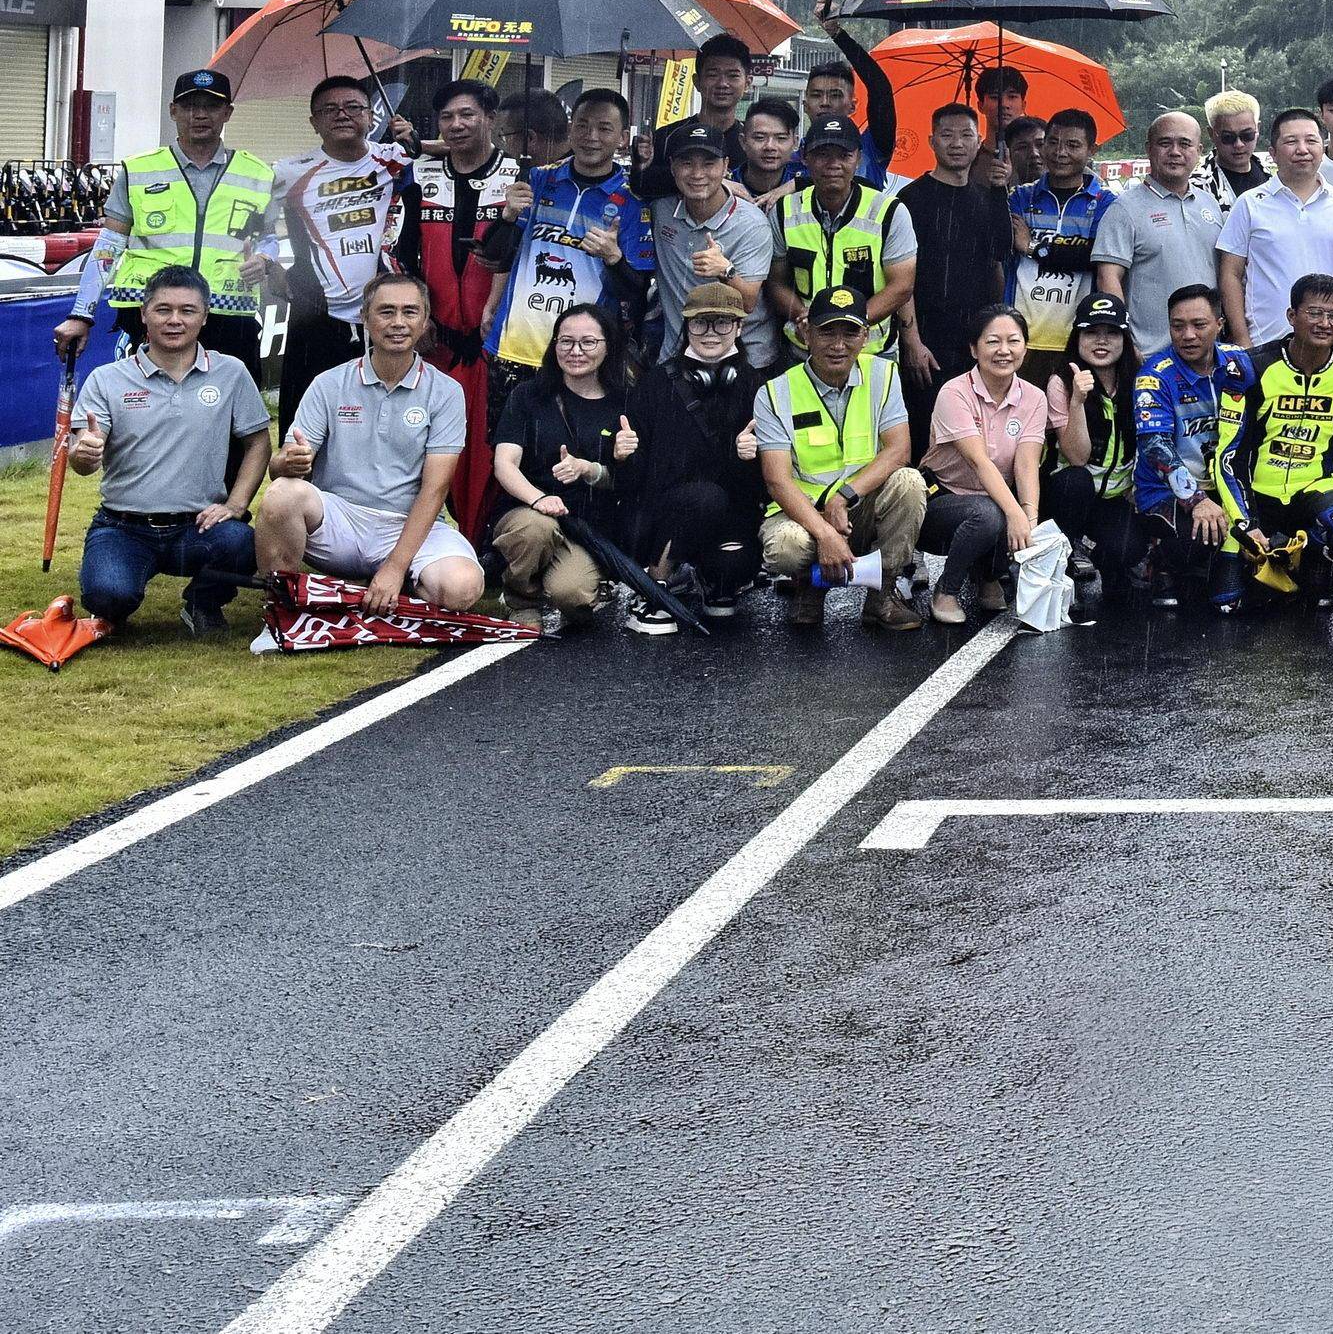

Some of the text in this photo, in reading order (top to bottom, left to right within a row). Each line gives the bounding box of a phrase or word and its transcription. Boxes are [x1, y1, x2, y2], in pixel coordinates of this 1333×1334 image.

[450, 19, 501, 33] TUPO
[673, 64, 689, 116] RACING
[338, 209, 372, 224] YBS
[1030, 283, 1072, 304] eni
[527, 291, 575, 314] eni
[1281, 397, 1325, 411] HFK
[1280, 442, 1313, 456] YBS
